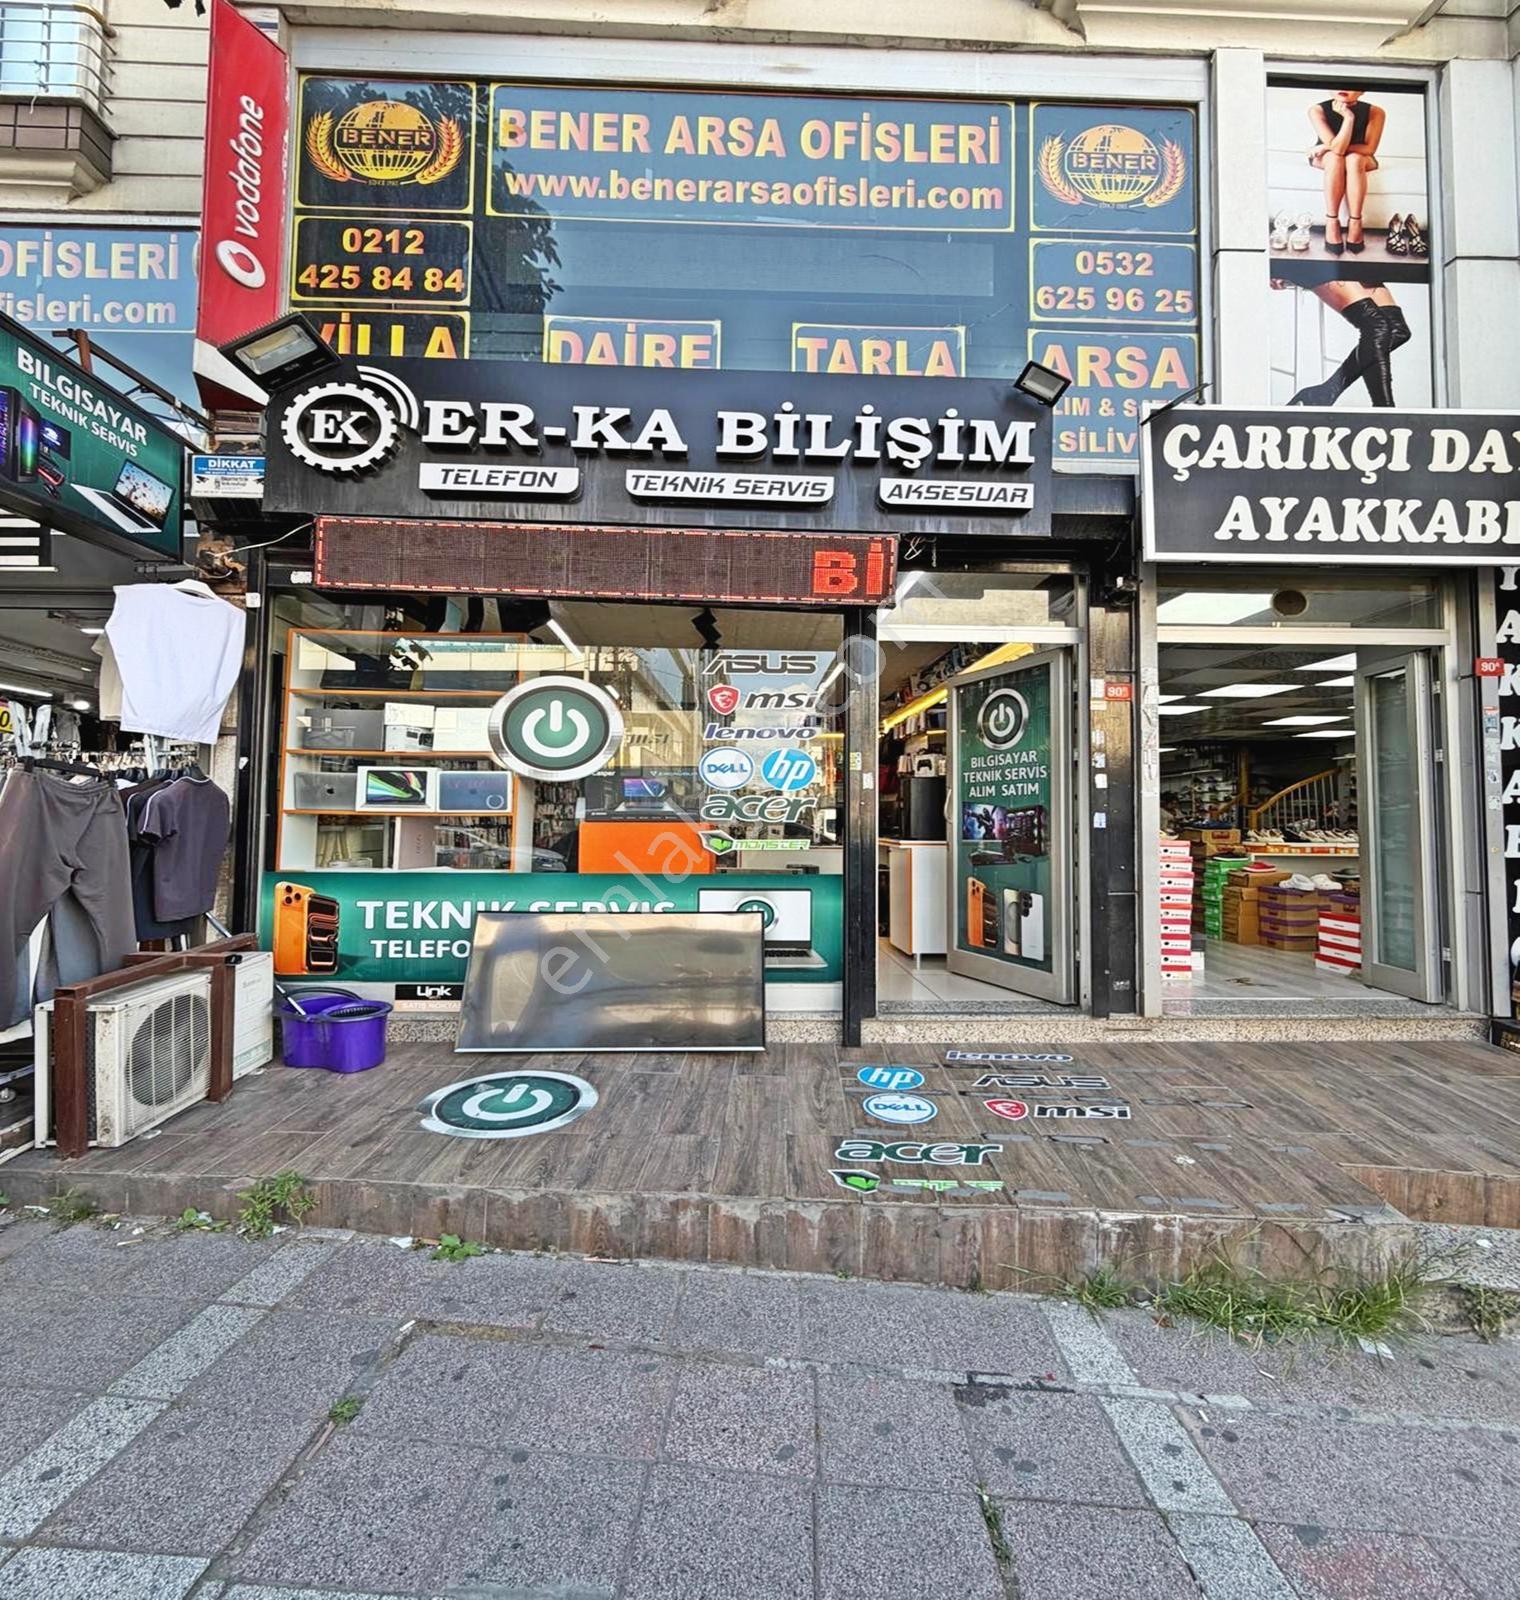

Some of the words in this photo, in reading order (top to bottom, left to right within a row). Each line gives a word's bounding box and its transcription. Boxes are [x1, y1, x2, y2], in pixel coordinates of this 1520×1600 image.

[342, 128, 431, 146] BENER
[500, 108, 650, 154] BENER
[664, 114, 788, 160] ARSA
[800, 112, 1000, 165] OFİSLERİ
[234, 95, 265, 239] vodafone
[1072, 153, 1157, 170] BENER
[506, 169, 1003, 210] www.benerarsaofisleri.com
[343, 227, 425, 256] 0212
[1076, 251, 1154, 277] 0532
[299, 264, 361, 290] 425
[372, 267, 413, 292] 84
[424, 268, 466, 294] 84
[1036, 287, 1096, 312] 625
[1106, 288, 1145, 313] 96
[1155, 289, 1194, 314] 25
[550, 323, 712, 370] DAİRE
[797, 337, 958, 377] TARLA
[18, 347, 148, 446] BILGISAYAR
[1053, 397, 1090, 416] LIM
[1098, 397, 1116, 417] &
[30, 383, 88, 429] TEKNIK
[91, 423, 138, 457] SERVIS
[309, 409, 369, 445] EK
[421, 400, 688, 452] ER-KA
[716, 401, 1037, 469] BİLİŞİM
[1059, 427, 1137, 454] SİLİV
[207, 458, 256, 469] DİKKAT
[1163, 423, 1413, 484] ÇARIKÇI
[1427, 427, 1520, 474] DA
[440, 467, 557, 488] TELEFON
[630, 473, 727, 494] TEKNİK
[733, 478, 829, 498] SERVİS
[886, 483, 1029, 503] AKSESUAR
[703, 654, 817, 675] ASUS
[744, 691, 818, 709] msi
[704, 723, 817, 740] lenovo
[707, 763, 748, 774] DELL
[770, 749, 810, 791] hp
[702, 795, 817, 822] acer
[356, 900, 516, 930] TEKN
[370, 940, 471, 959] TELEFO
[947, 1050, 1074, 1063] lenovo
[866, 1067, 915, 1088] hp
[972, 1074, 1112, 1089] ASUS
[873, 1102, 928, 1112] DELL
[1034, 1104, 1131, 1120] msi
[835, 1140, 1003, 1166] acer
